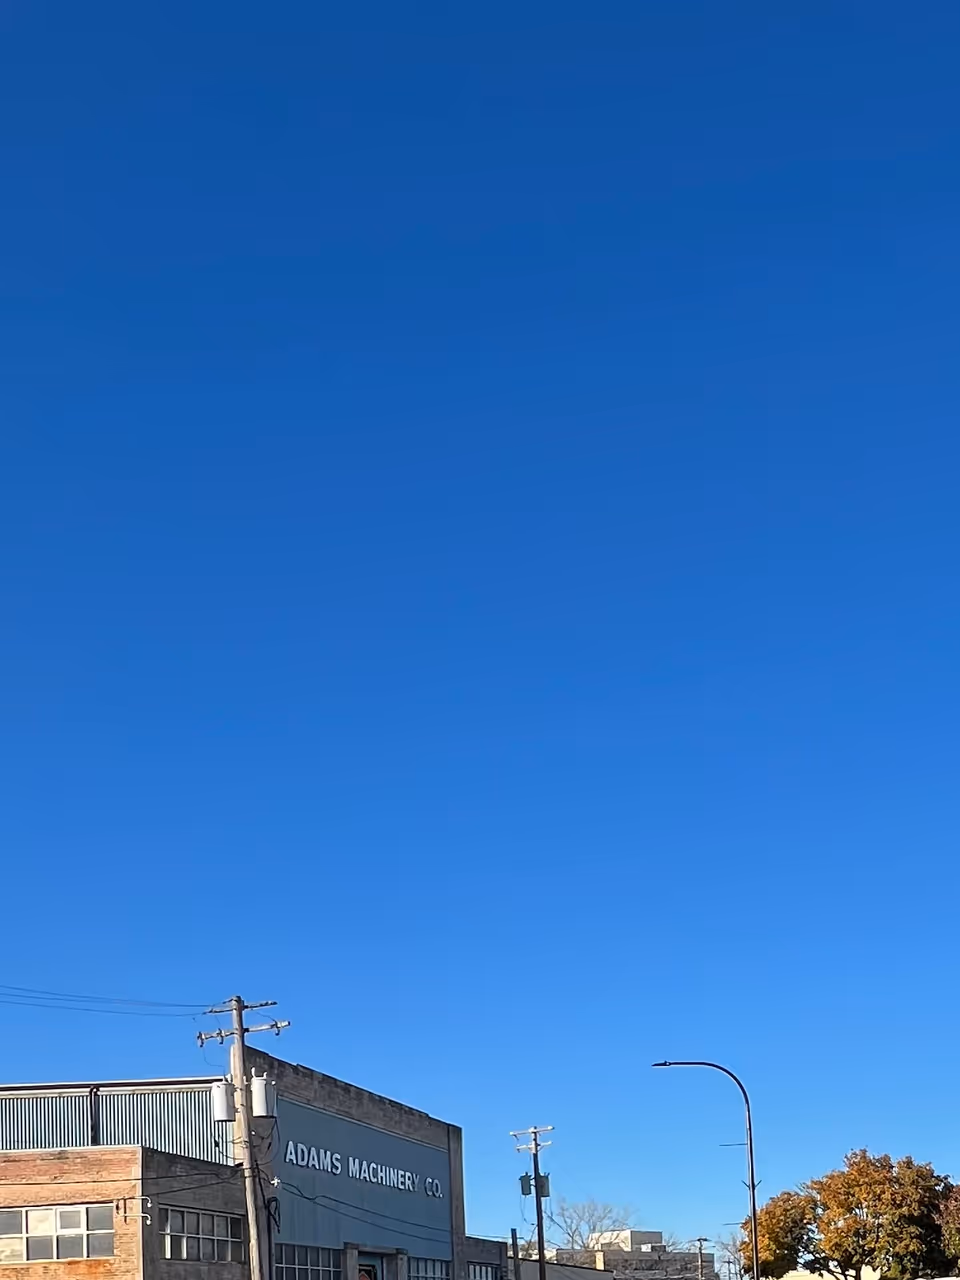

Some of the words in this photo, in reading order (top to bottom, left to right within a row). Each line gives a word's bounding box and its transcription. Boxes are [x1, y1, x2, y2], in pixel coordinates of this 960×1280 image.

[285, 1140, 342, 1175] ADAMS
[348, 1157, 420, 1192] MACHINERY
[424, 1177, 444, 1198] CO.
